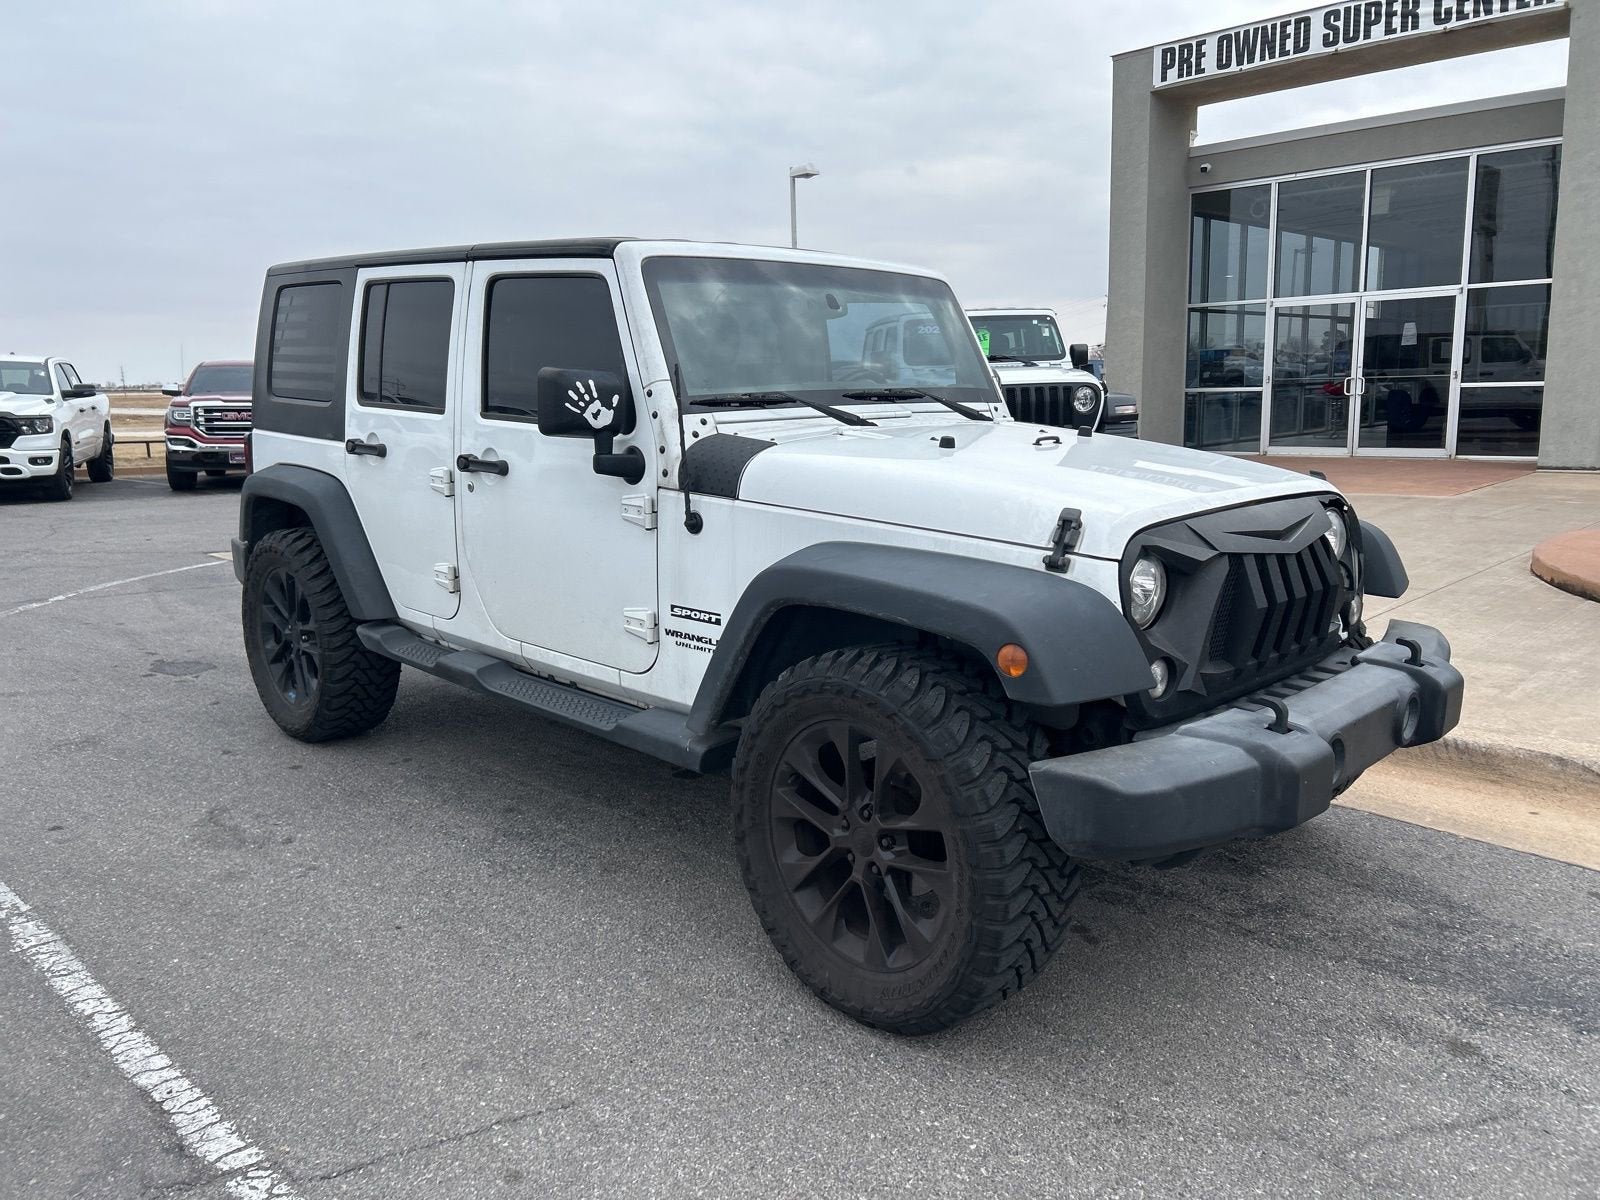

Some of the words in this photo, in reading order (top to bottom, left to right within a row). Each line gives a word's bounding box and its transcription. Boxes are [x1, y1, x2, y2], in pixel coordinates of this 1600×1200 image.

[1160, 39, 1207, 83] PRE
[1216, 15, 1312, 71] OWNED
[1322, 0, 1421, 48] SUPER
[1433, 0, 1556, 26] CEN
[221, 411, 252, 421] GMC
[670, 605, 721, 625] SPORT
[664, 628, 719, 646] WRANGL
[675, 640, 714, 654] UNLIMIT
